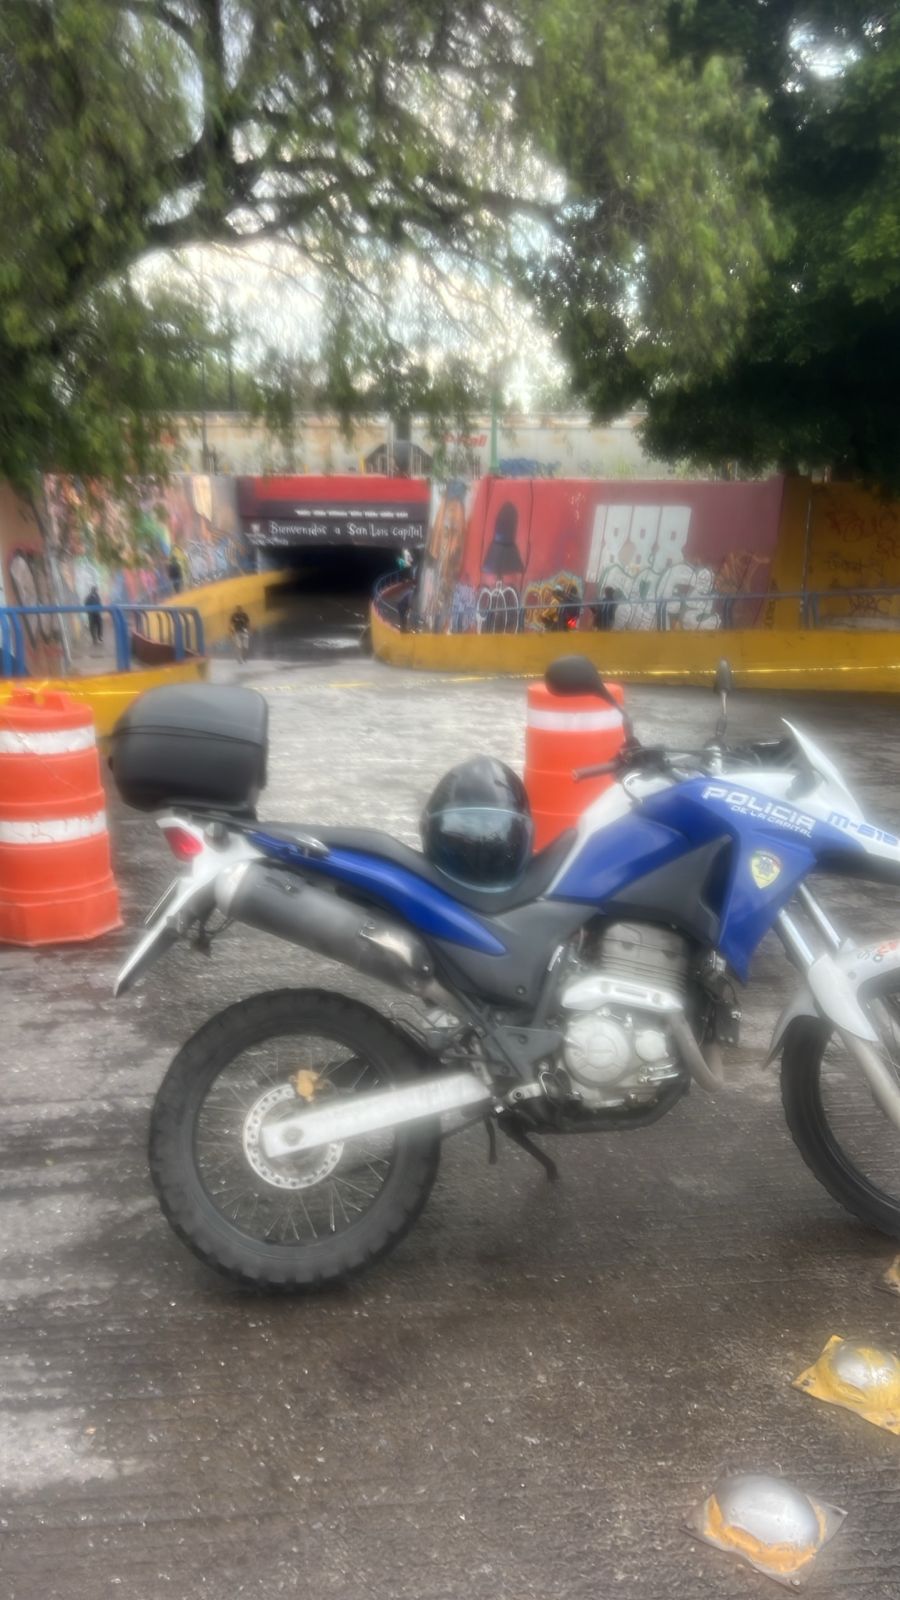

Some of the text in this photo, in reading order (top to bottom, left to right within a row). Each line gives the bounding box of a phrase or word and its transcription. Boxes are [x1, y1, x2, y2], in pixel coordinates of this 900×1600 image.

[270, 520, 327, 537] Bienvenidos
[347, 523, 368, 536] San
[702, 786, 817, 831] POLICIA
[730, 805, 747, 815] DE
[767, 816, 813, 839] CAPITAL
